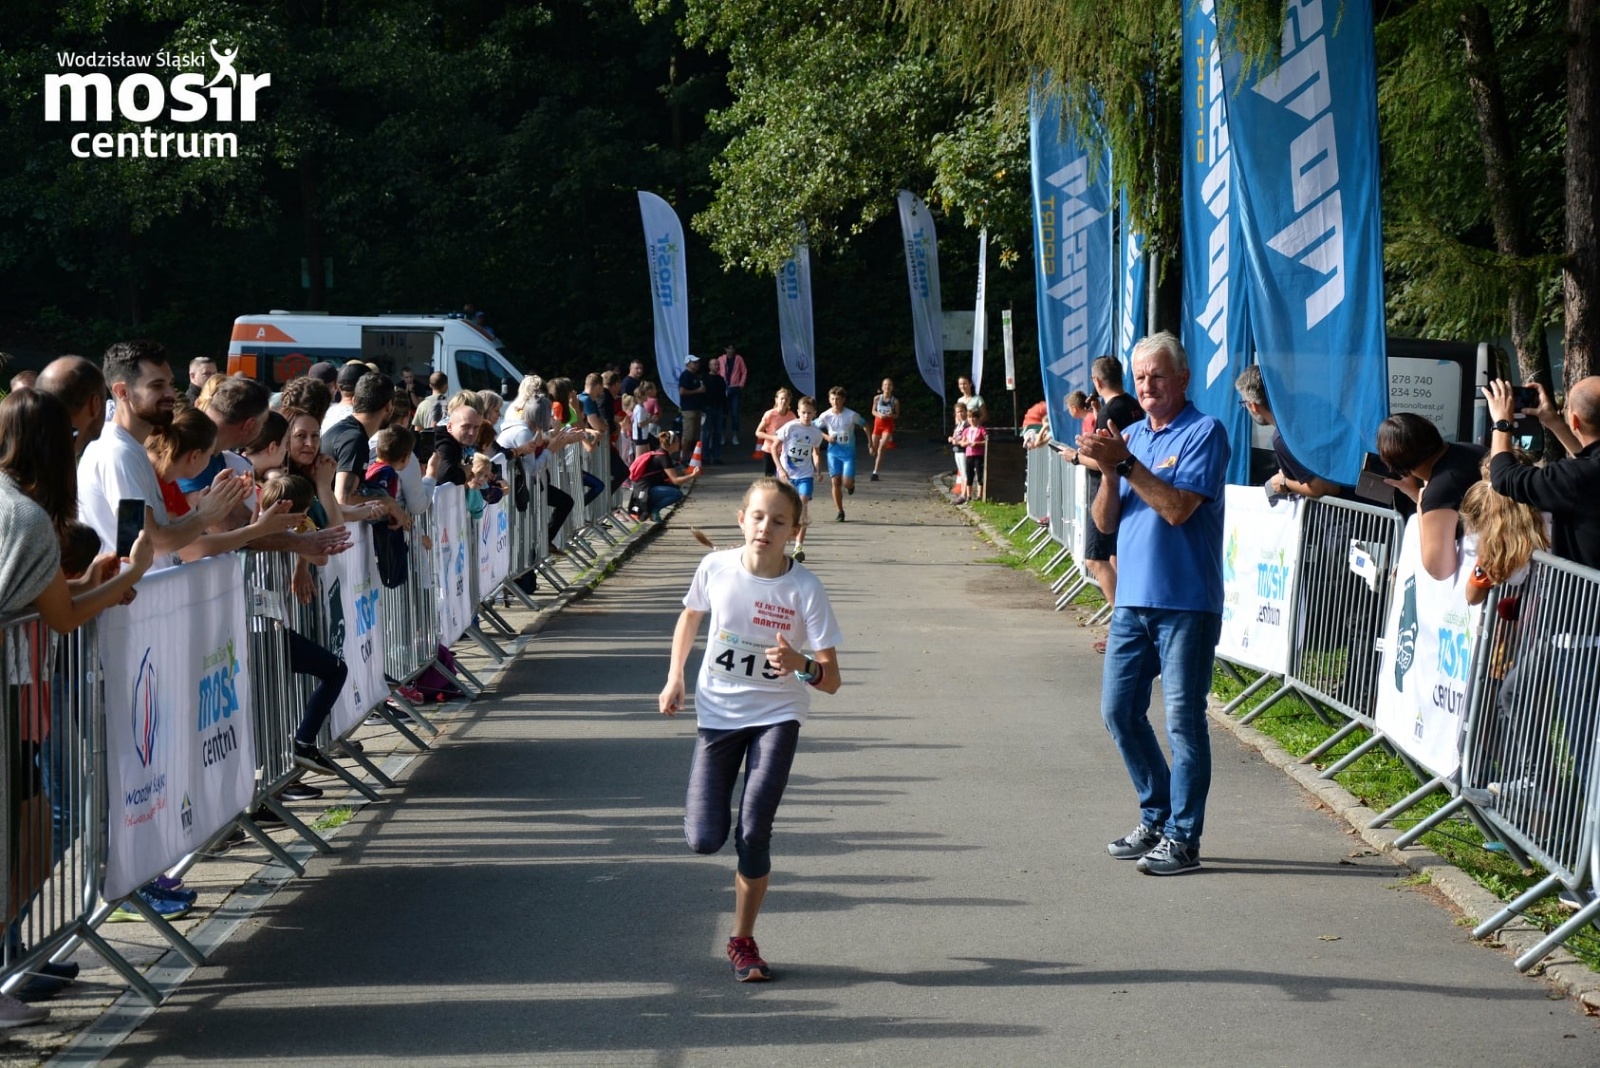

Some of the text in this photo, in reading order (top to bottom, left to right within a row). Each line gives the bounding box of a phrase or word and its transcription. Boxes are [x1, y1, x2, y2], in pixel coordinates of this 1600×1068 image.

[255, 326, 266, 339] A
[1391, 374, 1433, 386] 278 740
[1391, 387, 1432, 398] 234 596
[790, 447, 809, 457] 414
[777, 606, 796, 616] TEAM
